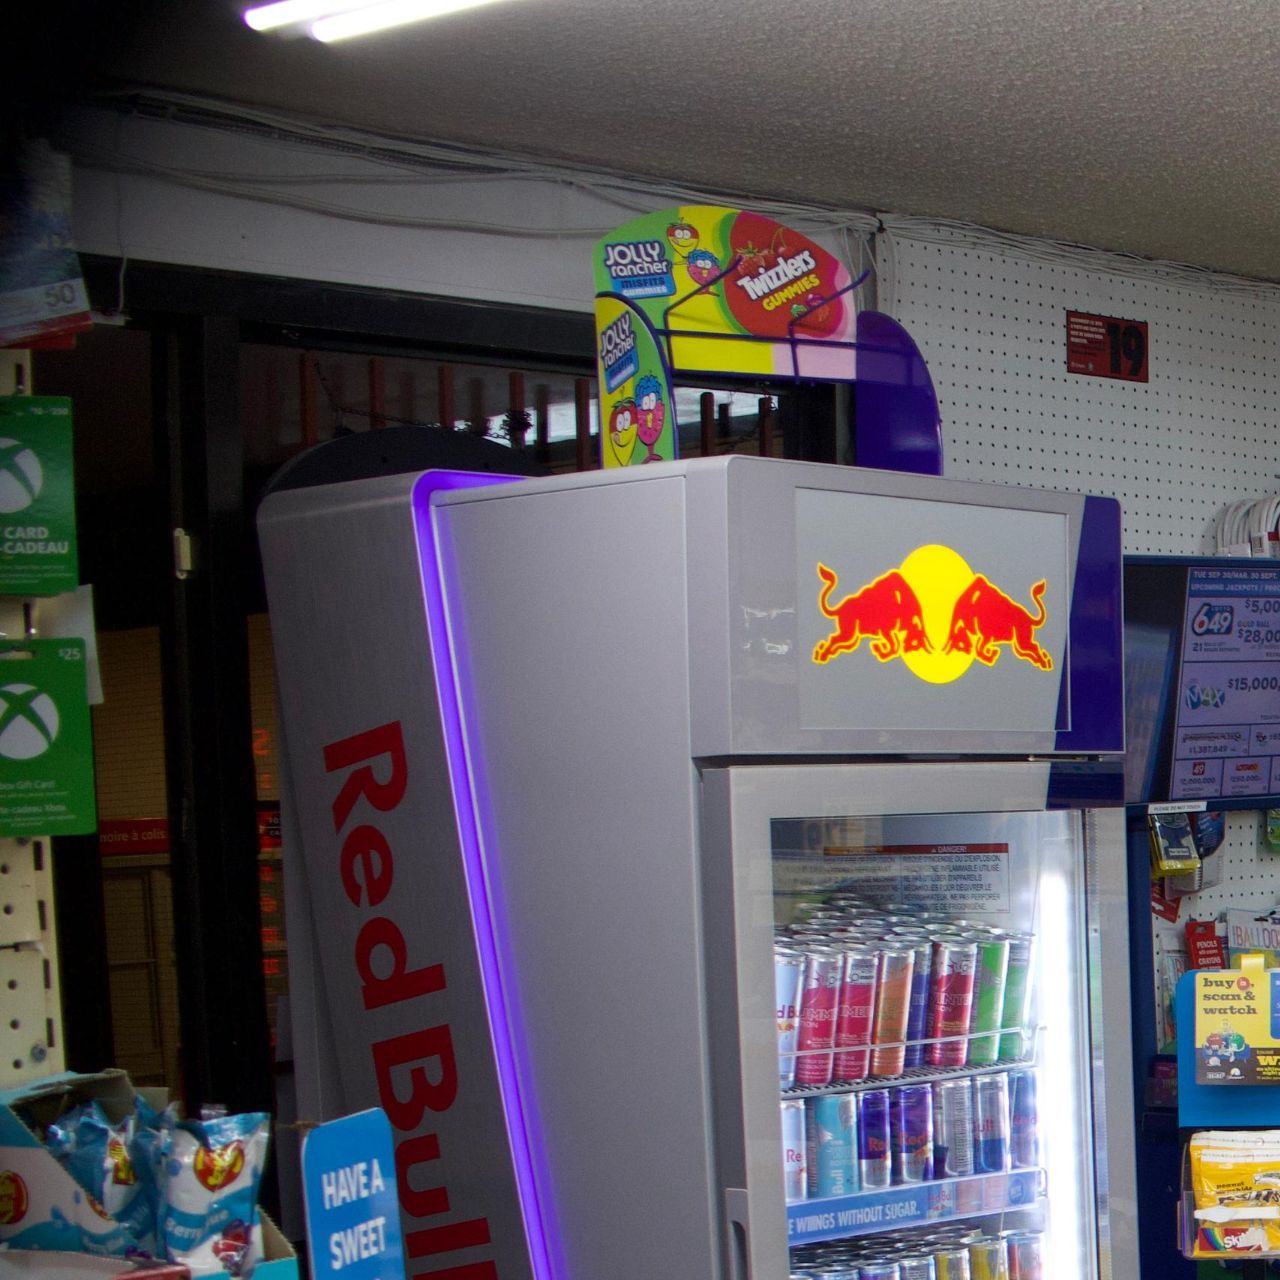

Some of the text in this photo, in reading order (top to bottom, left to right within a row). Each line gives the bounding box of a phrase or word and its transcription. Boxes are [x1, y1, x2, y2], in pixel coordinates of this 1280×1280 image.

[606, 242, 661, 265] JOLLY
[611, 259, 668, 277] rancher
[736, 249, 816, 301] Twizzlers
[762, 274, 820, 312] GUMMIES
[4, 527, 48, 539] CARD
[59, 648, 80, 660] $25
[323, 720, 447, 1010] Red
[1203, 978, 1235, 991] buy
[1203, 992, 1256, 1001] scan &
[1203, 1005, 1257, 1015] watch
[322, 1159, 384, 1209] HAVE A
[837, 1202, 921, 1228] WITHOUT SUGAR.
[330, 1217, 386, 1269] SWEET
